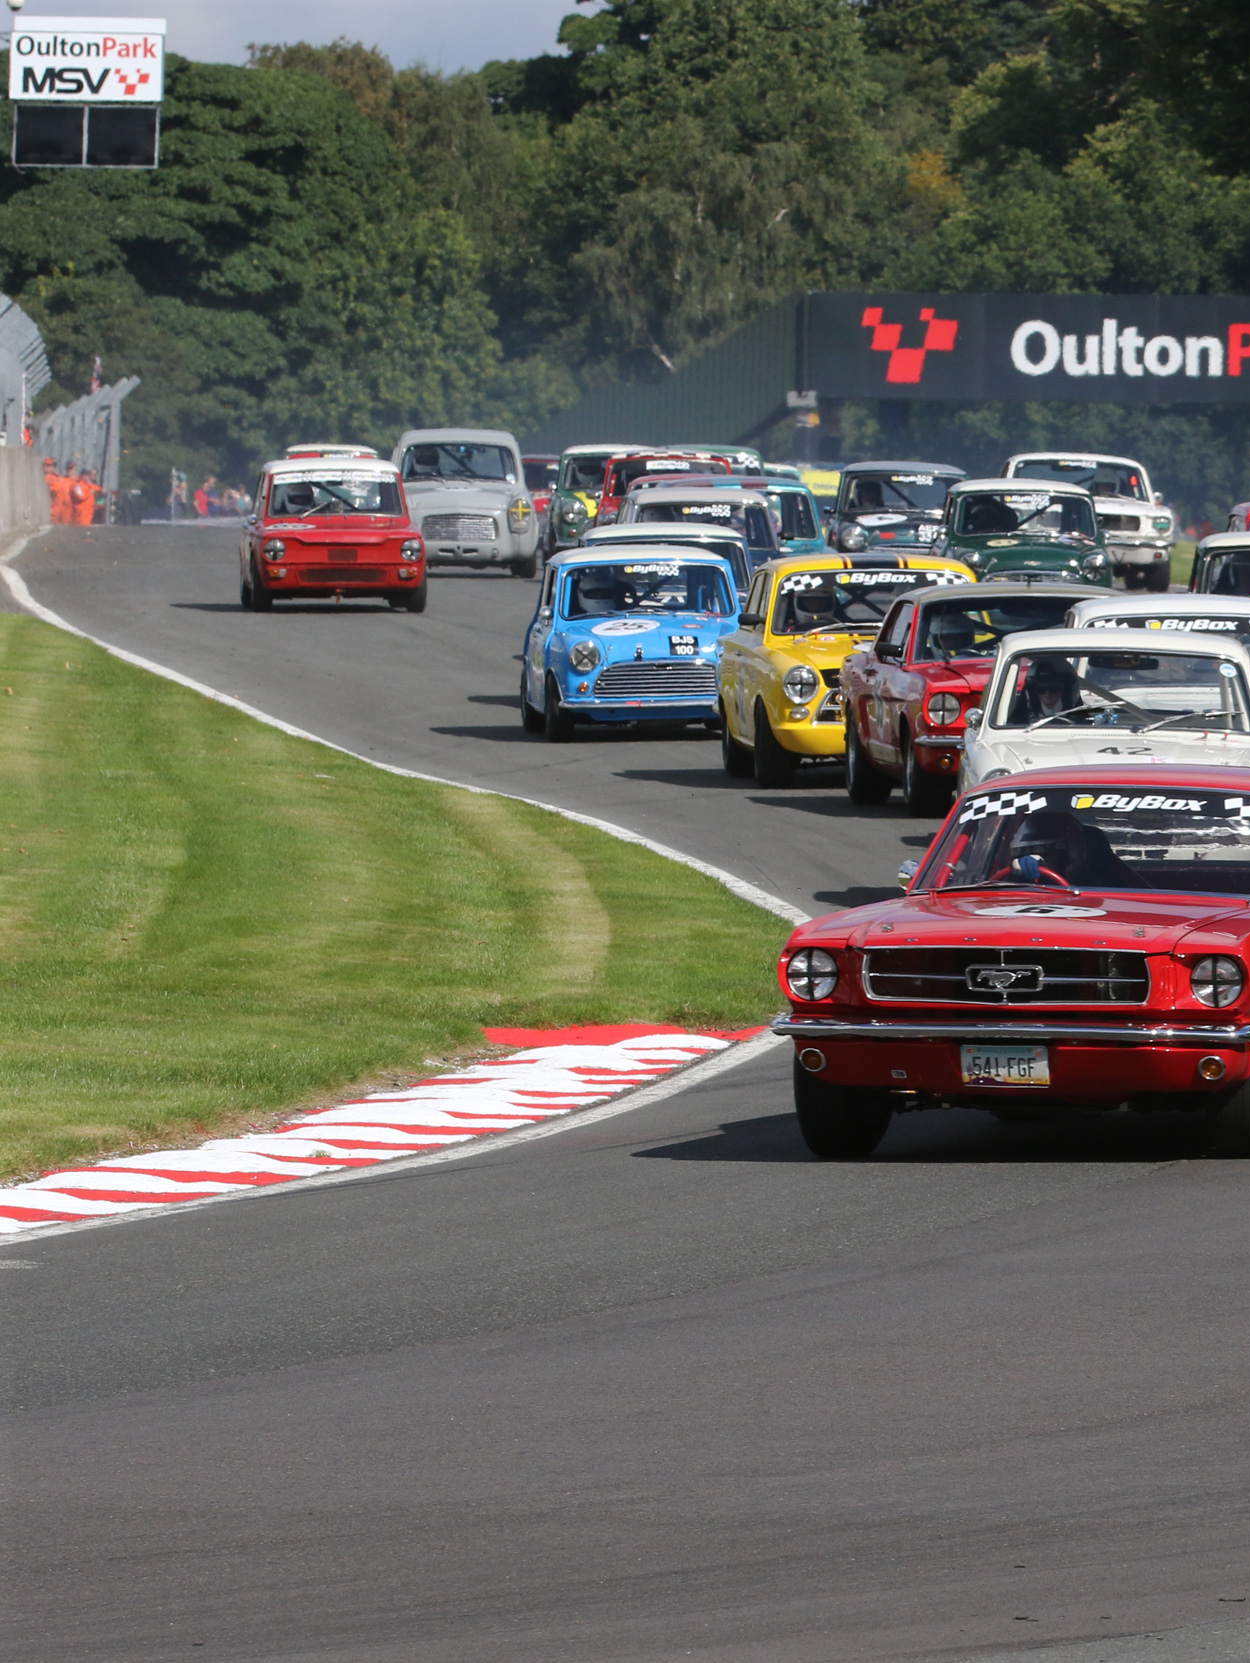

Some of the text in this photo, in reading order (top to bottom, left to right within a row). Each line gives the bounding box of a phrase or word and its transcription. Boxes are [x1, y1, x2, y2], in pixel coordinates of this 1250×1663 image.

[22, 67, 111, 94] MSV
[850, 572, 917, 585] ByBox
[1162, 619, 1239, 632] ByBox
[671, 635, 695, 644] BJS
[674, 645, 694, 655] 100
[1096, 746, 1154, 755] 42
[1092, 794, 1207, 812] ByBox
